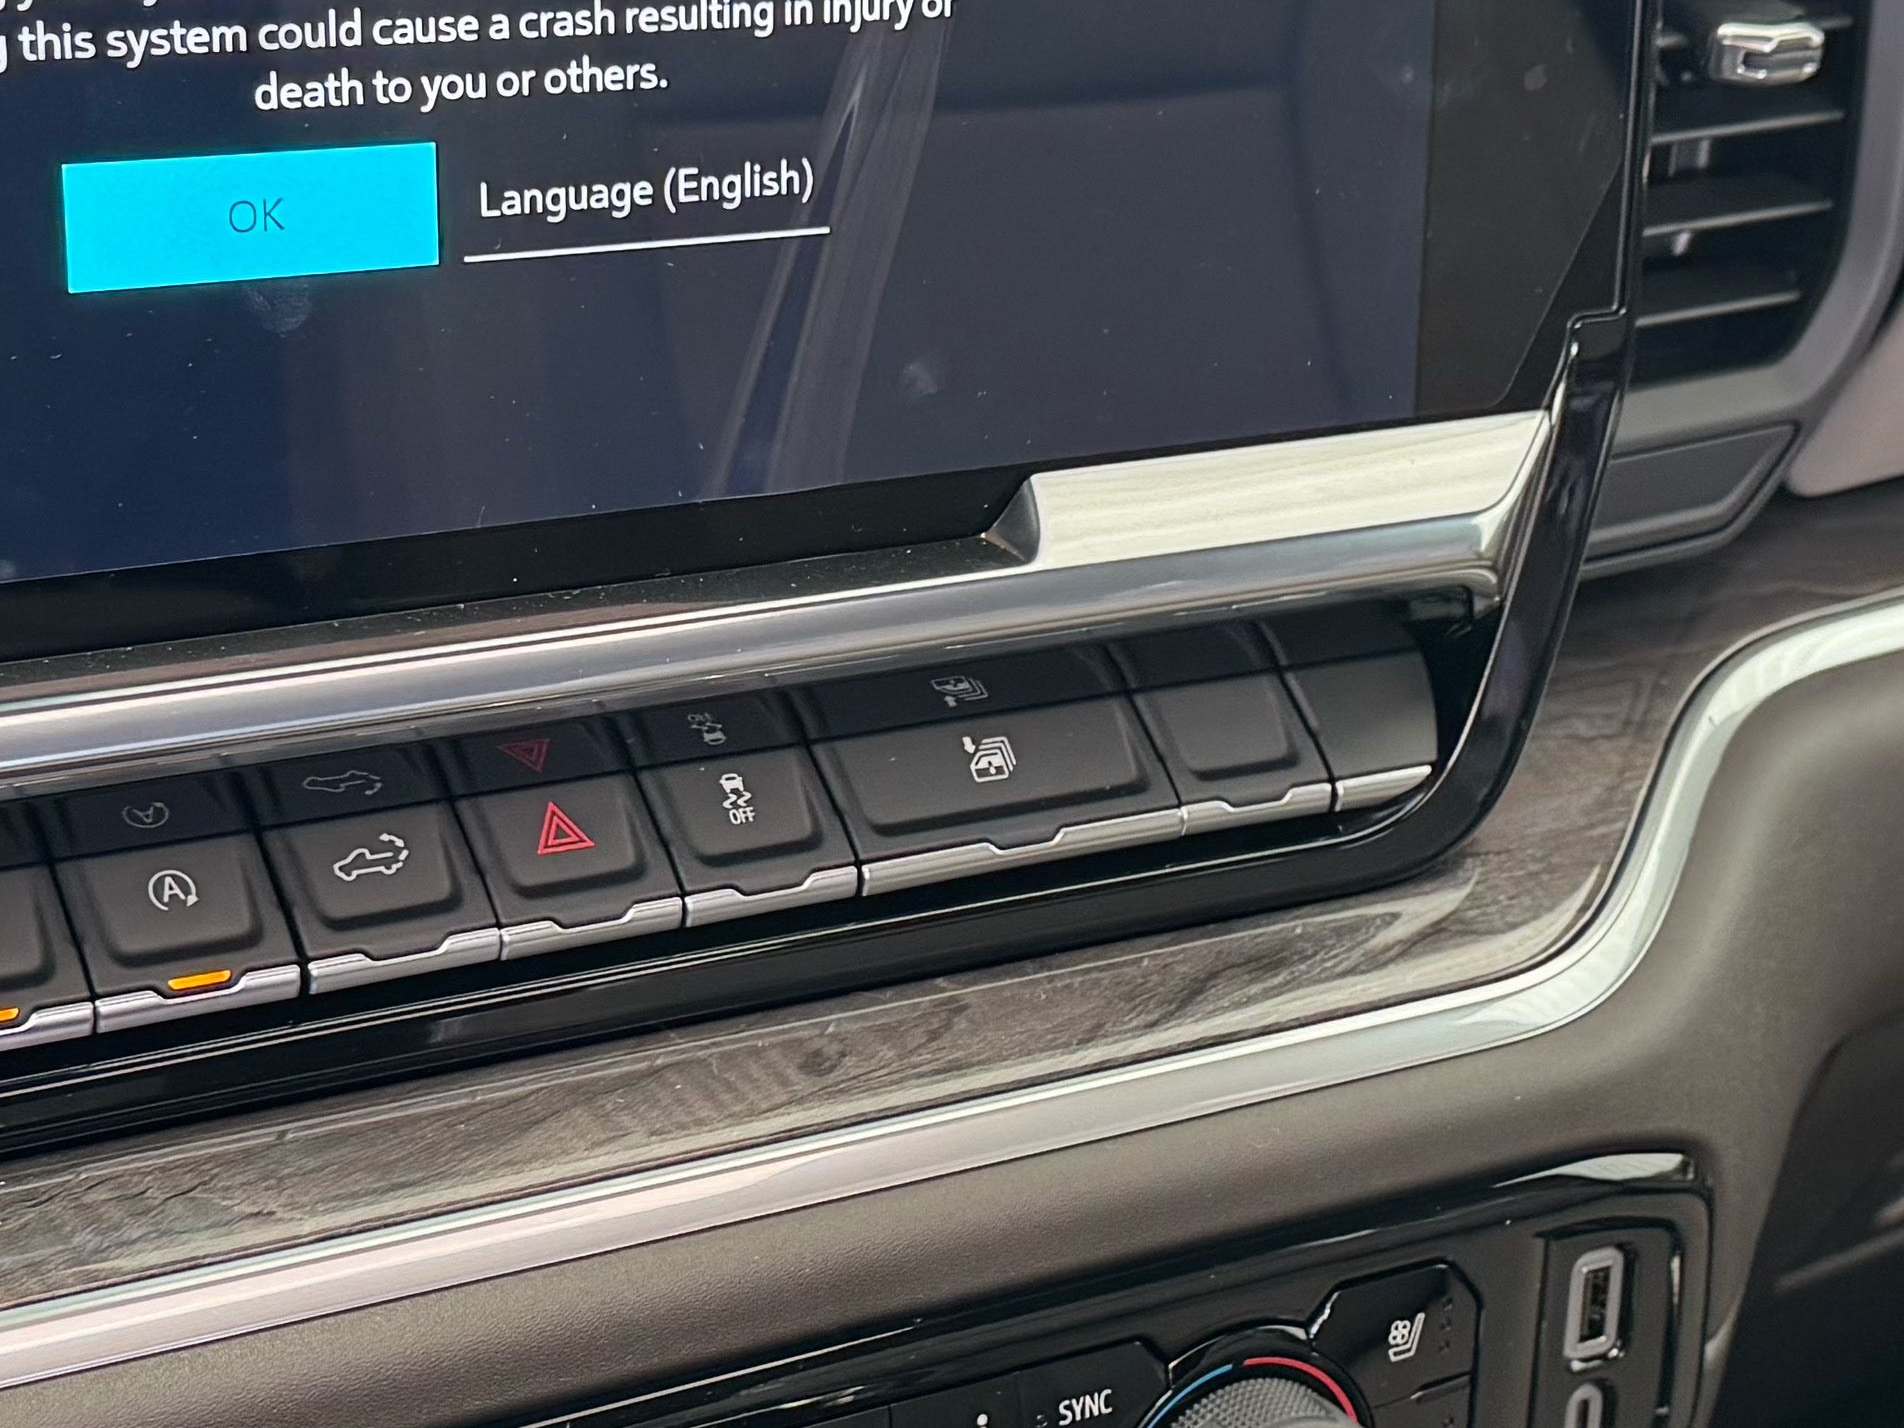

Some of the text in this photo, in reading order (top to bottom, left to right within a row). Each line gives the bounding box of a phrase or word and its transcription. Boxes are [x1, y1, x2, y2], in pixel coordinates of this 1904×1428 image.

[17, 19, 96, 61] this
[106, 19, 247, 69] system
[258, 7, 362, 51] could
[372, 14, 480, 46] cause
[488, 13, 510, 40] a
[254, 54, 668, 113] death to you or others.
[480, 157, 814, 223] Language (English)
[229, 196, 286, 237] OK
[729, 806, 756, 825] OFF
[1058, 1388, 1113, 1426] SYNC
